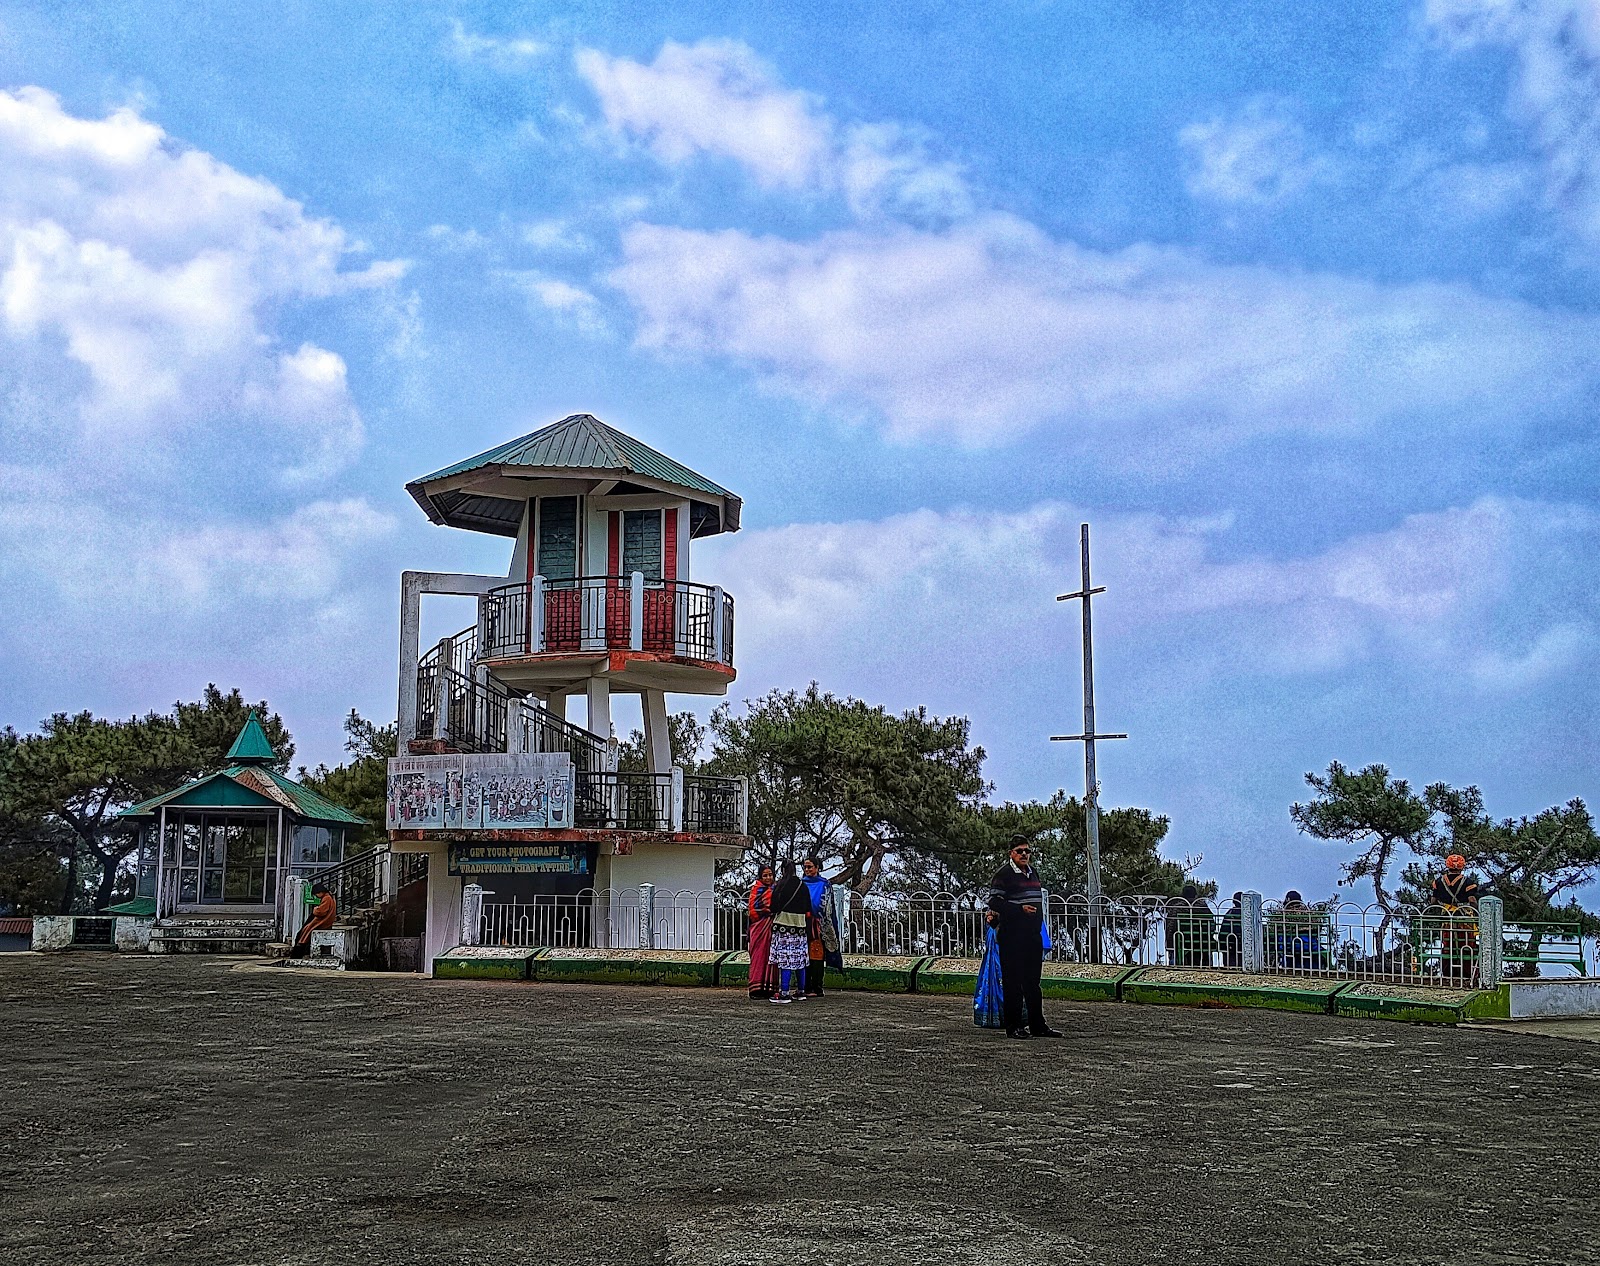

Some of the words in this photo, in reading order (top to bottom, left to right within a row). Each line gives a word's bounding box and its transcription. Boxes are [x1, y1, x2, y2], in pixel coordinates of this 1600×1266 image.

[469, 847, 485, 858] GET
[487, 847, 507, 858] YOUR
[508, 846, 560, 857] PHOTOGRAPH
[459, 863, 513, 873] TRADITIONAL
[514, 863, 538, 872] KHASI
[539, 862, 570, 872] ATTIRE
